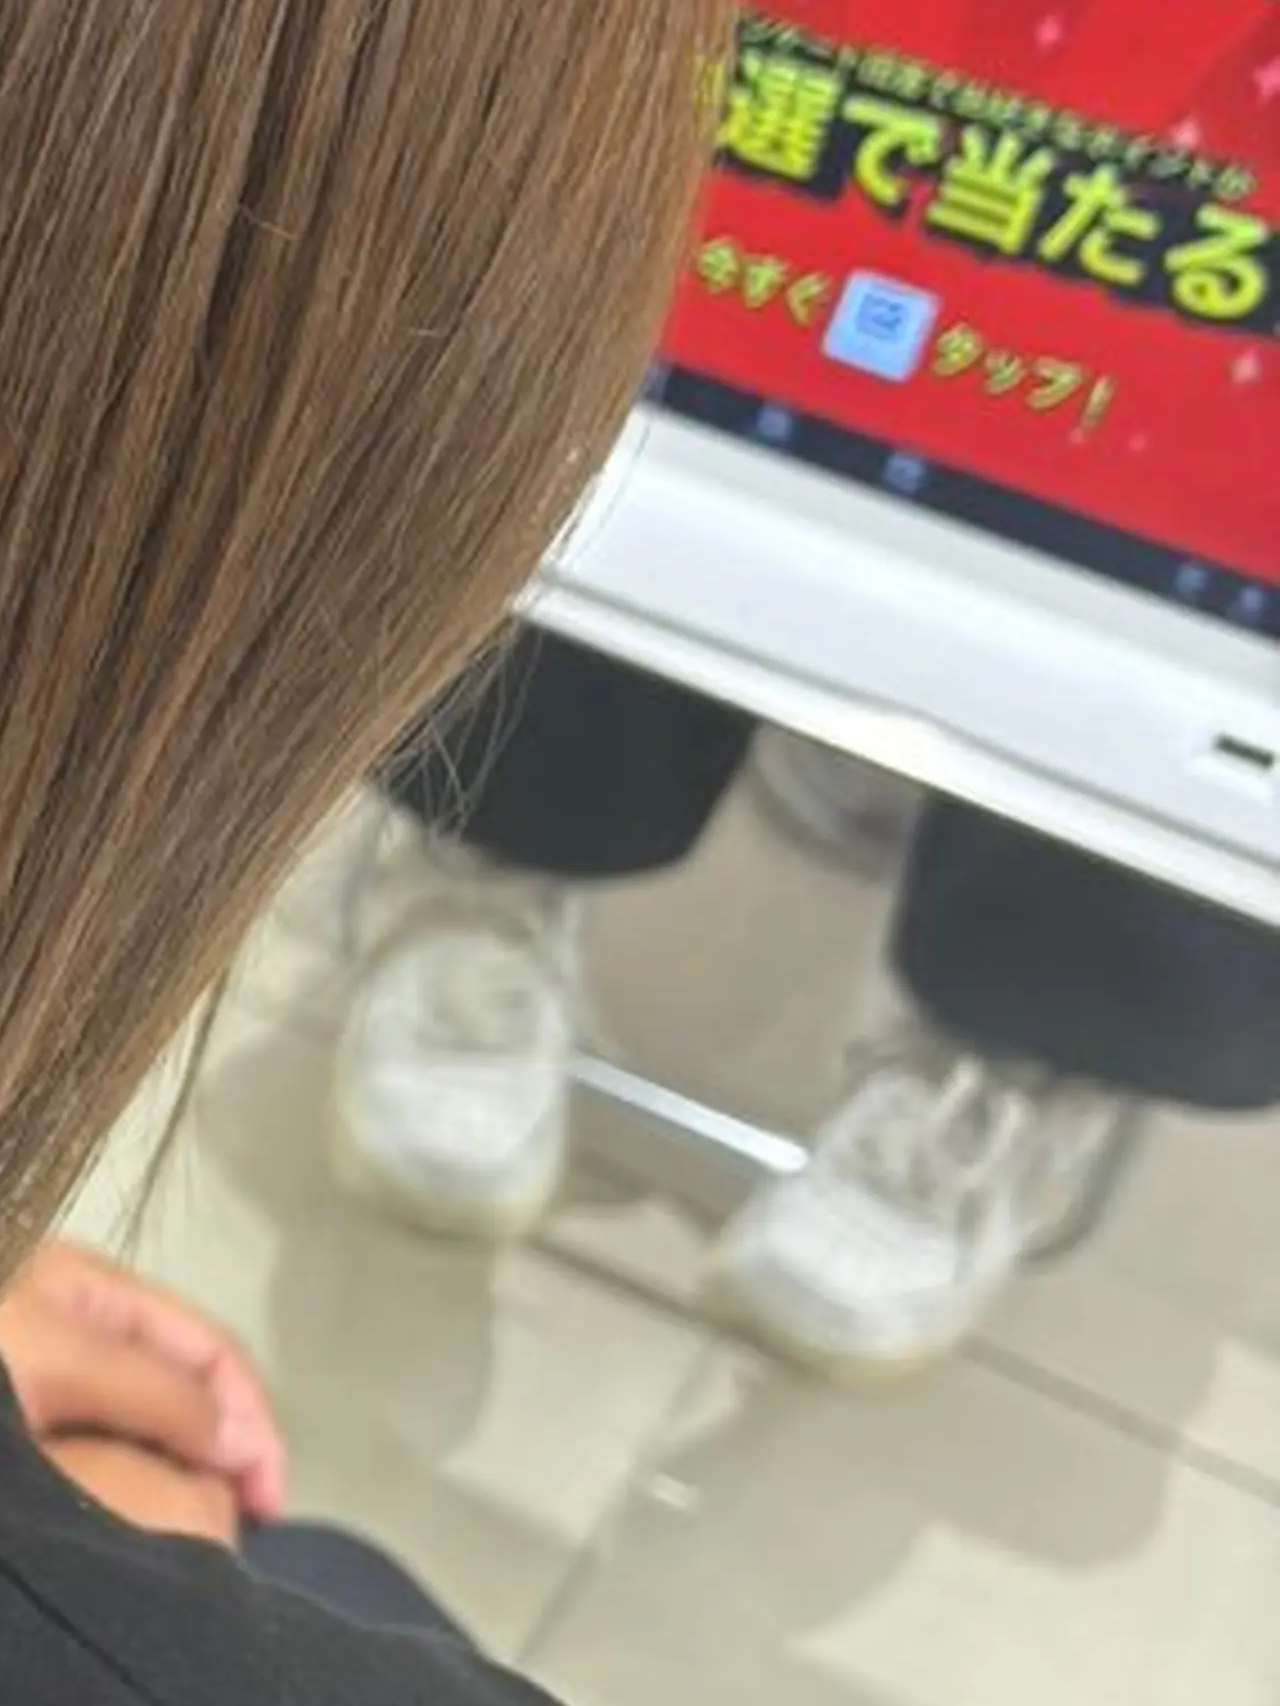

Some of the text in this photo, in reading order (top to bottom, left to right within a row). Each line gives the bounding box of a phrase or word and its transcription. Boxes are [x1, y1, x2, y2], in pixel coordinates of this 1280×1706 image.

[712, 45, 1270, 323] 選で当たる
[696, 235, 830, 325] 今すぐ
